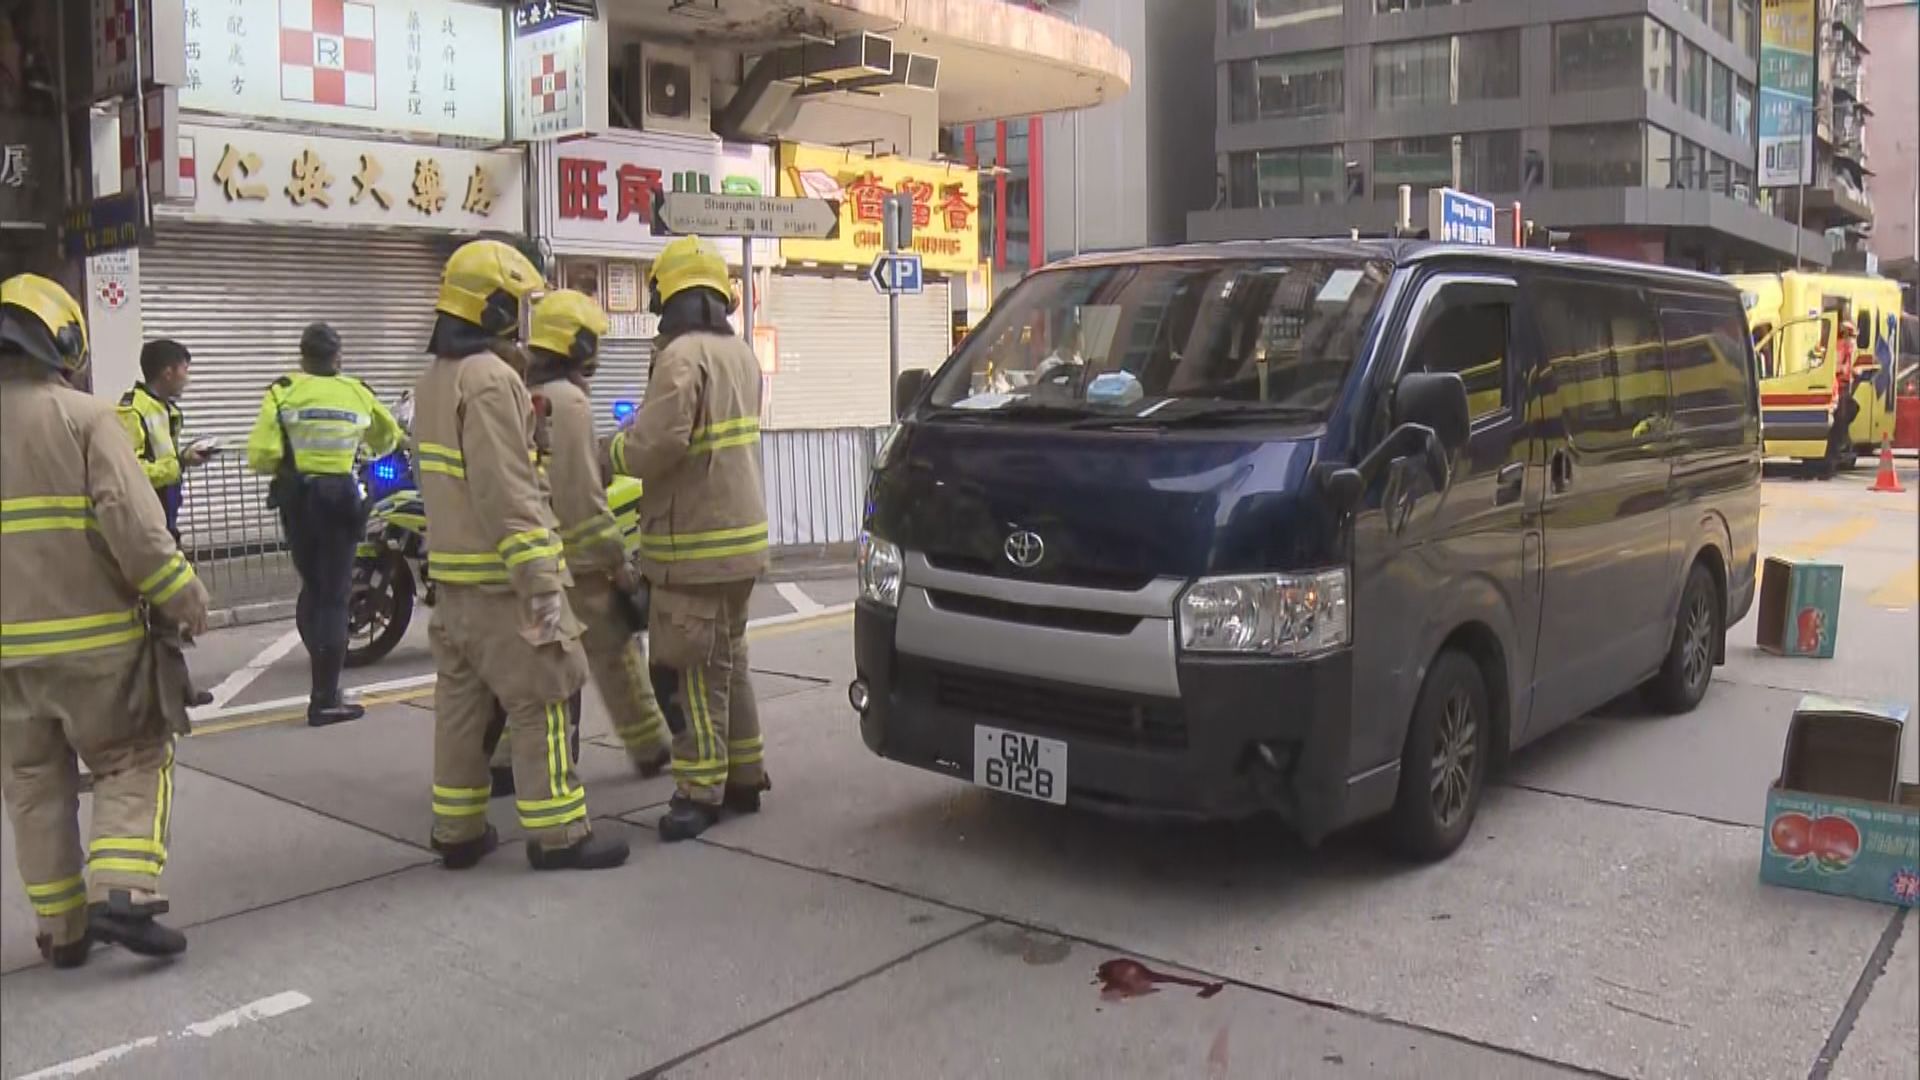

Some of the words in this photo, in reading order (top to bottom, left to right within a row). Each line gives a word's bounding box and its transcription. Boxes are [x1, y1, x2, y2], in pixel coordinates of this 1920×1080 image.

[515, 0, 560, 28] 仁安大
[212, 142, 496, 217] 仁安大藥房
[703, 198, 756, 213] Shanghai
[759, 201, 795, 214] Street
[895, 261, 914, 289] P
[1001, 732, 1039, 768] GM
[986, 757, 1054, 799] 6128
